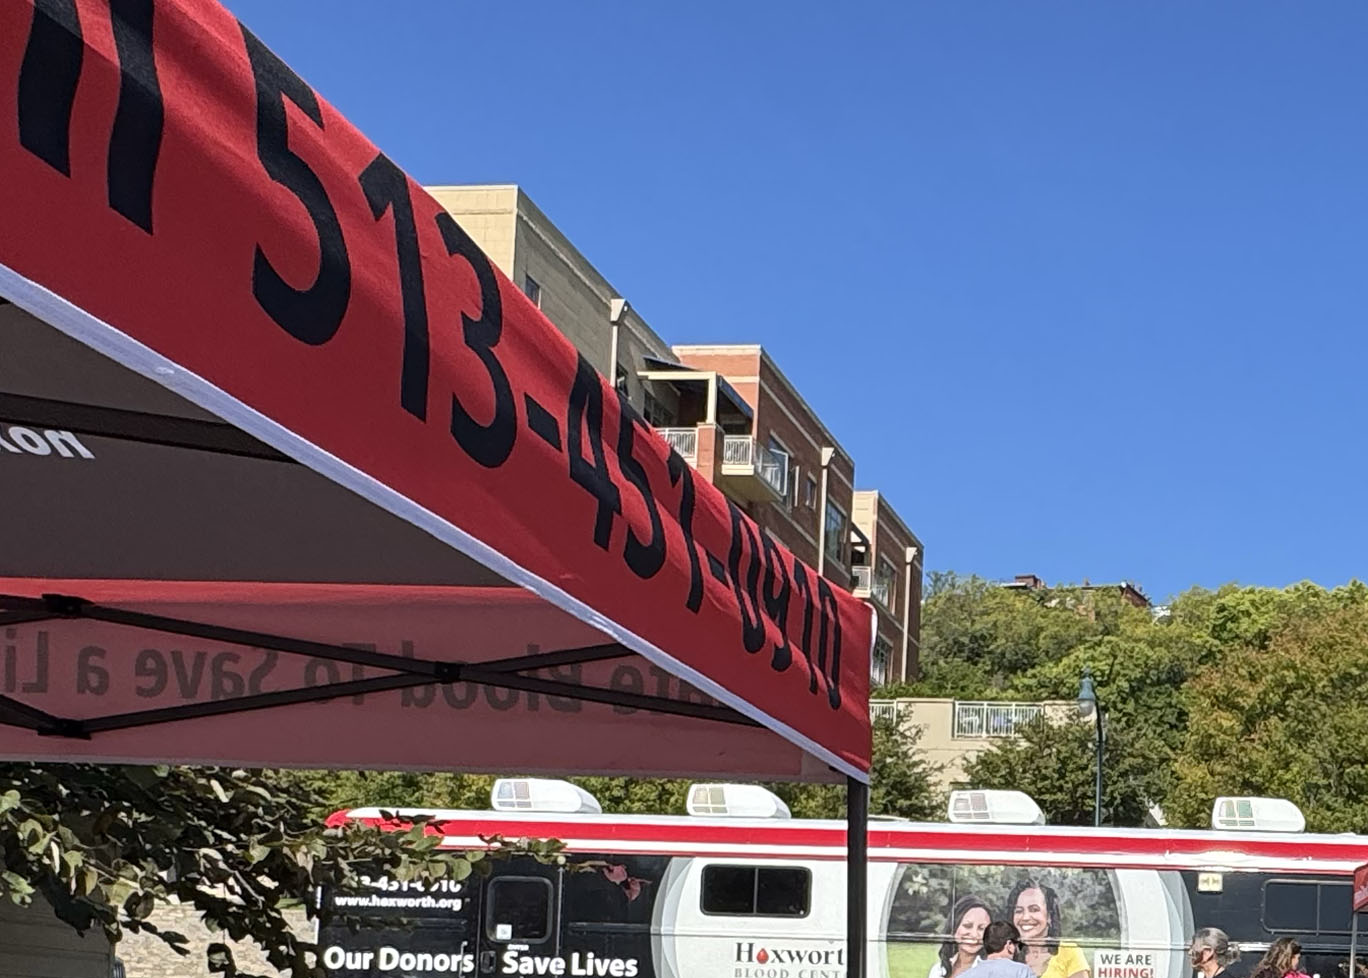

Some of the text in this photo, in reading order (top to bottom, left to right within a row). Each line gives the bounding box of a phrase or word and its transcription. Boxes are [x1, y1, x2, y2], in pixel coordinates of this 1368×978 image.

[238, 20, 842, 710] 513-451-0910
[324, 946, 638, 977] Our Donors Save Lives
[1100, 953, 1152, 966] WE ARE
[1098, 967, 1154, 978] HIRING!
